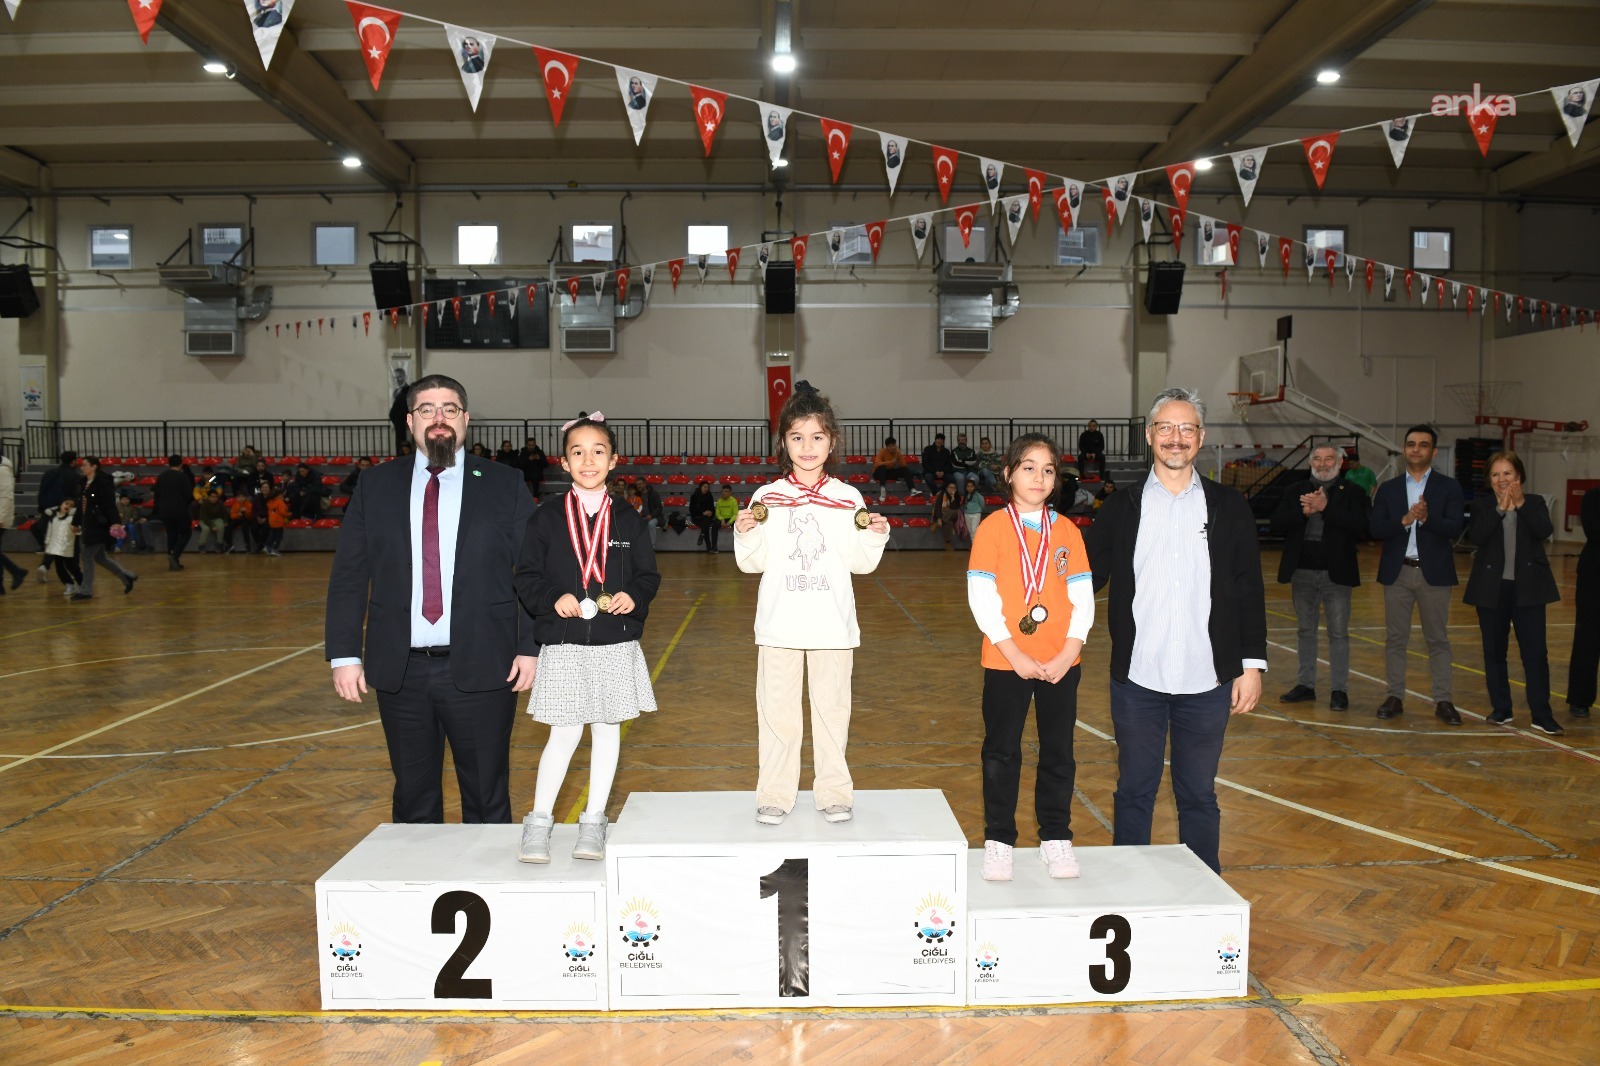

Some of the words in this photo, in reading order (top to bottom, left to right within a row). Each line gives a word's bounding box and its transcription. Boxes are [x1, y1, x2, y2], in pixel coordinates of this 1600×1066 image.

[785, 574, 830, 592] USPA
[431, 890, 493, 999] 2
[759, 858, 810, 997] 1
[1088, 914, 1132, 995] 3
